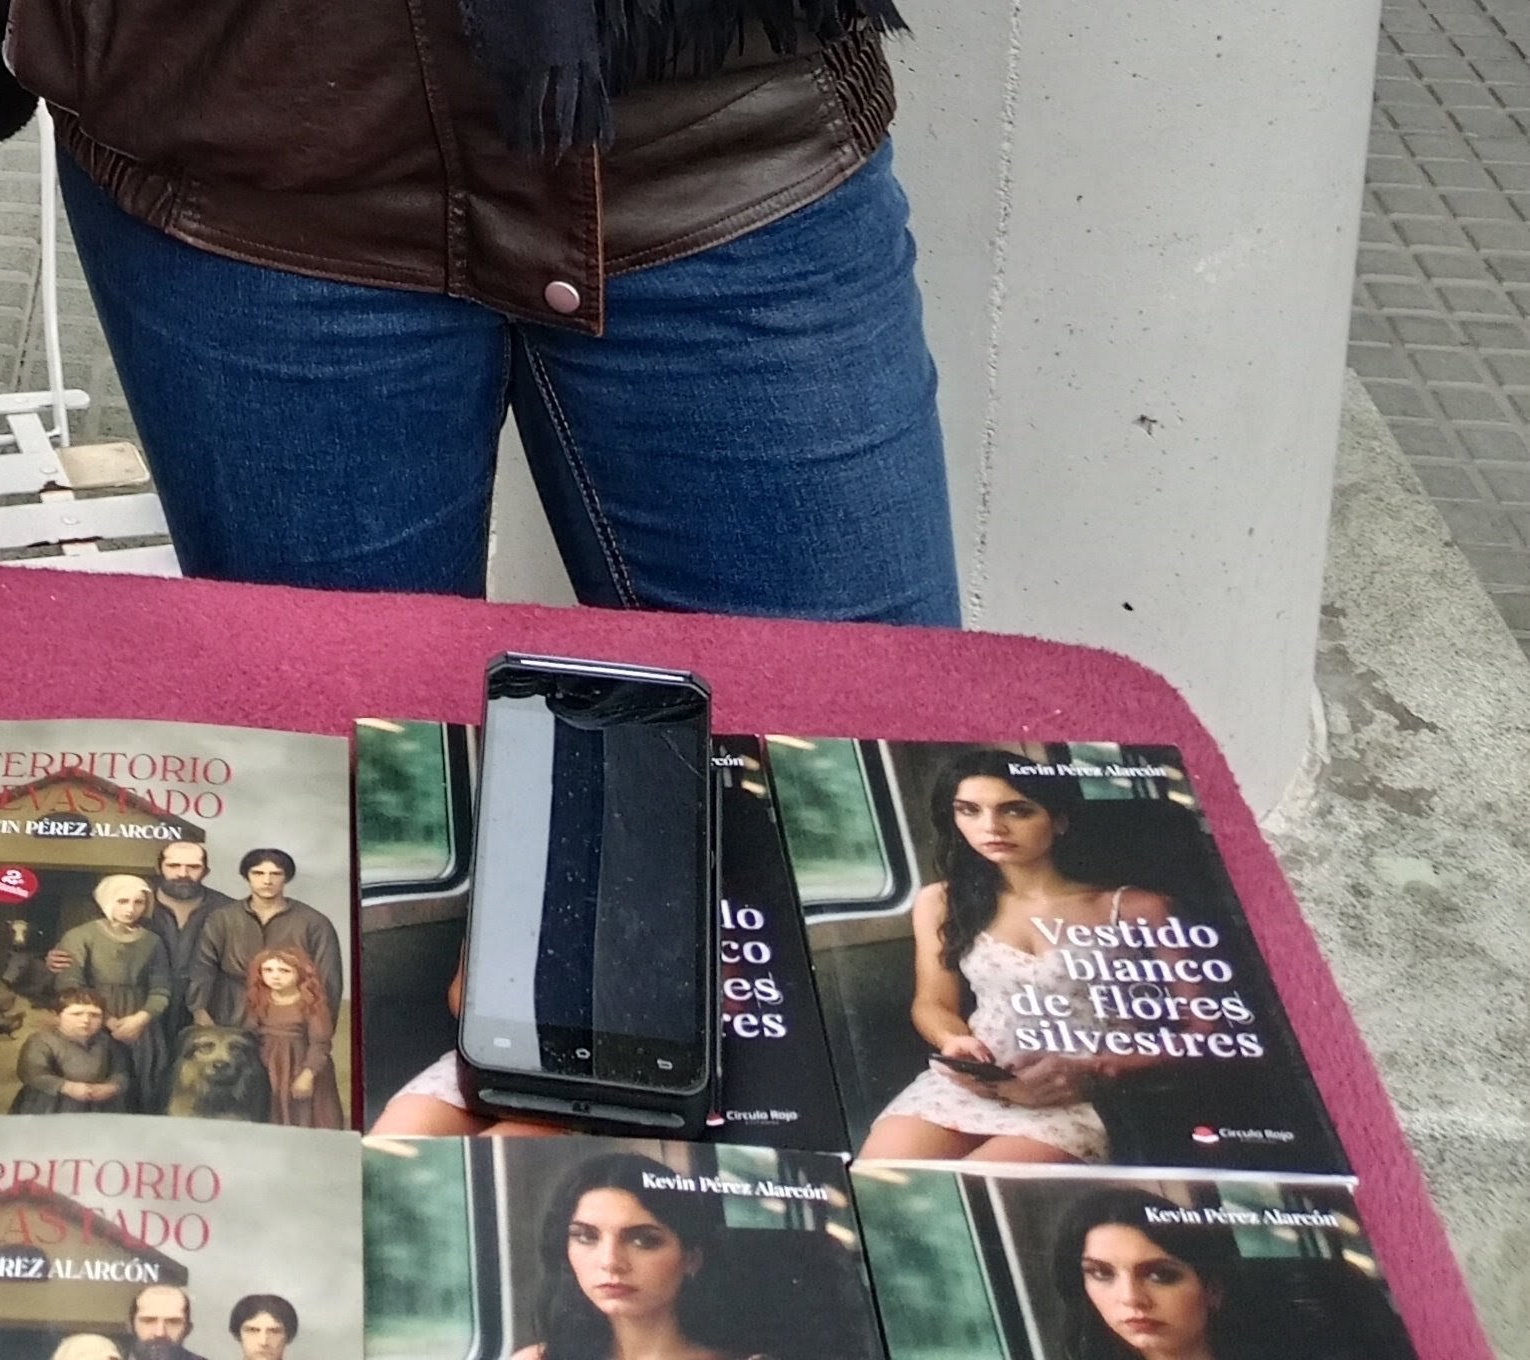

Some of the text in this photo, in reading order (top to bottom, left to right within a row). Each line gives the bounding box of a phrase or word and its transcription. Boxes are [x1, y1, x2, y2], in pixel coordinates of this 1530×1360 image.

[1008, 762, 1167, 777] Kevin Pérez Alarcón
[25, 817, 89, 837] PÉREZ
[90, 822, 183, 841] ALARCÓN
[1030, 917, 1220, 949] Vestido
[1060, 949, 1233, 983] blanco
[1010, 983, 1253, 1022] de flores
[1015, 1019, 1265, 1058] silvestres
[642, 1172, 828, 1201] Kevin Pérez Alarcón
[1145, 1206, 1339, 1227] Kevin Pérez Alarcón
[48, 1257, 160, 1284] ALARCÓN
